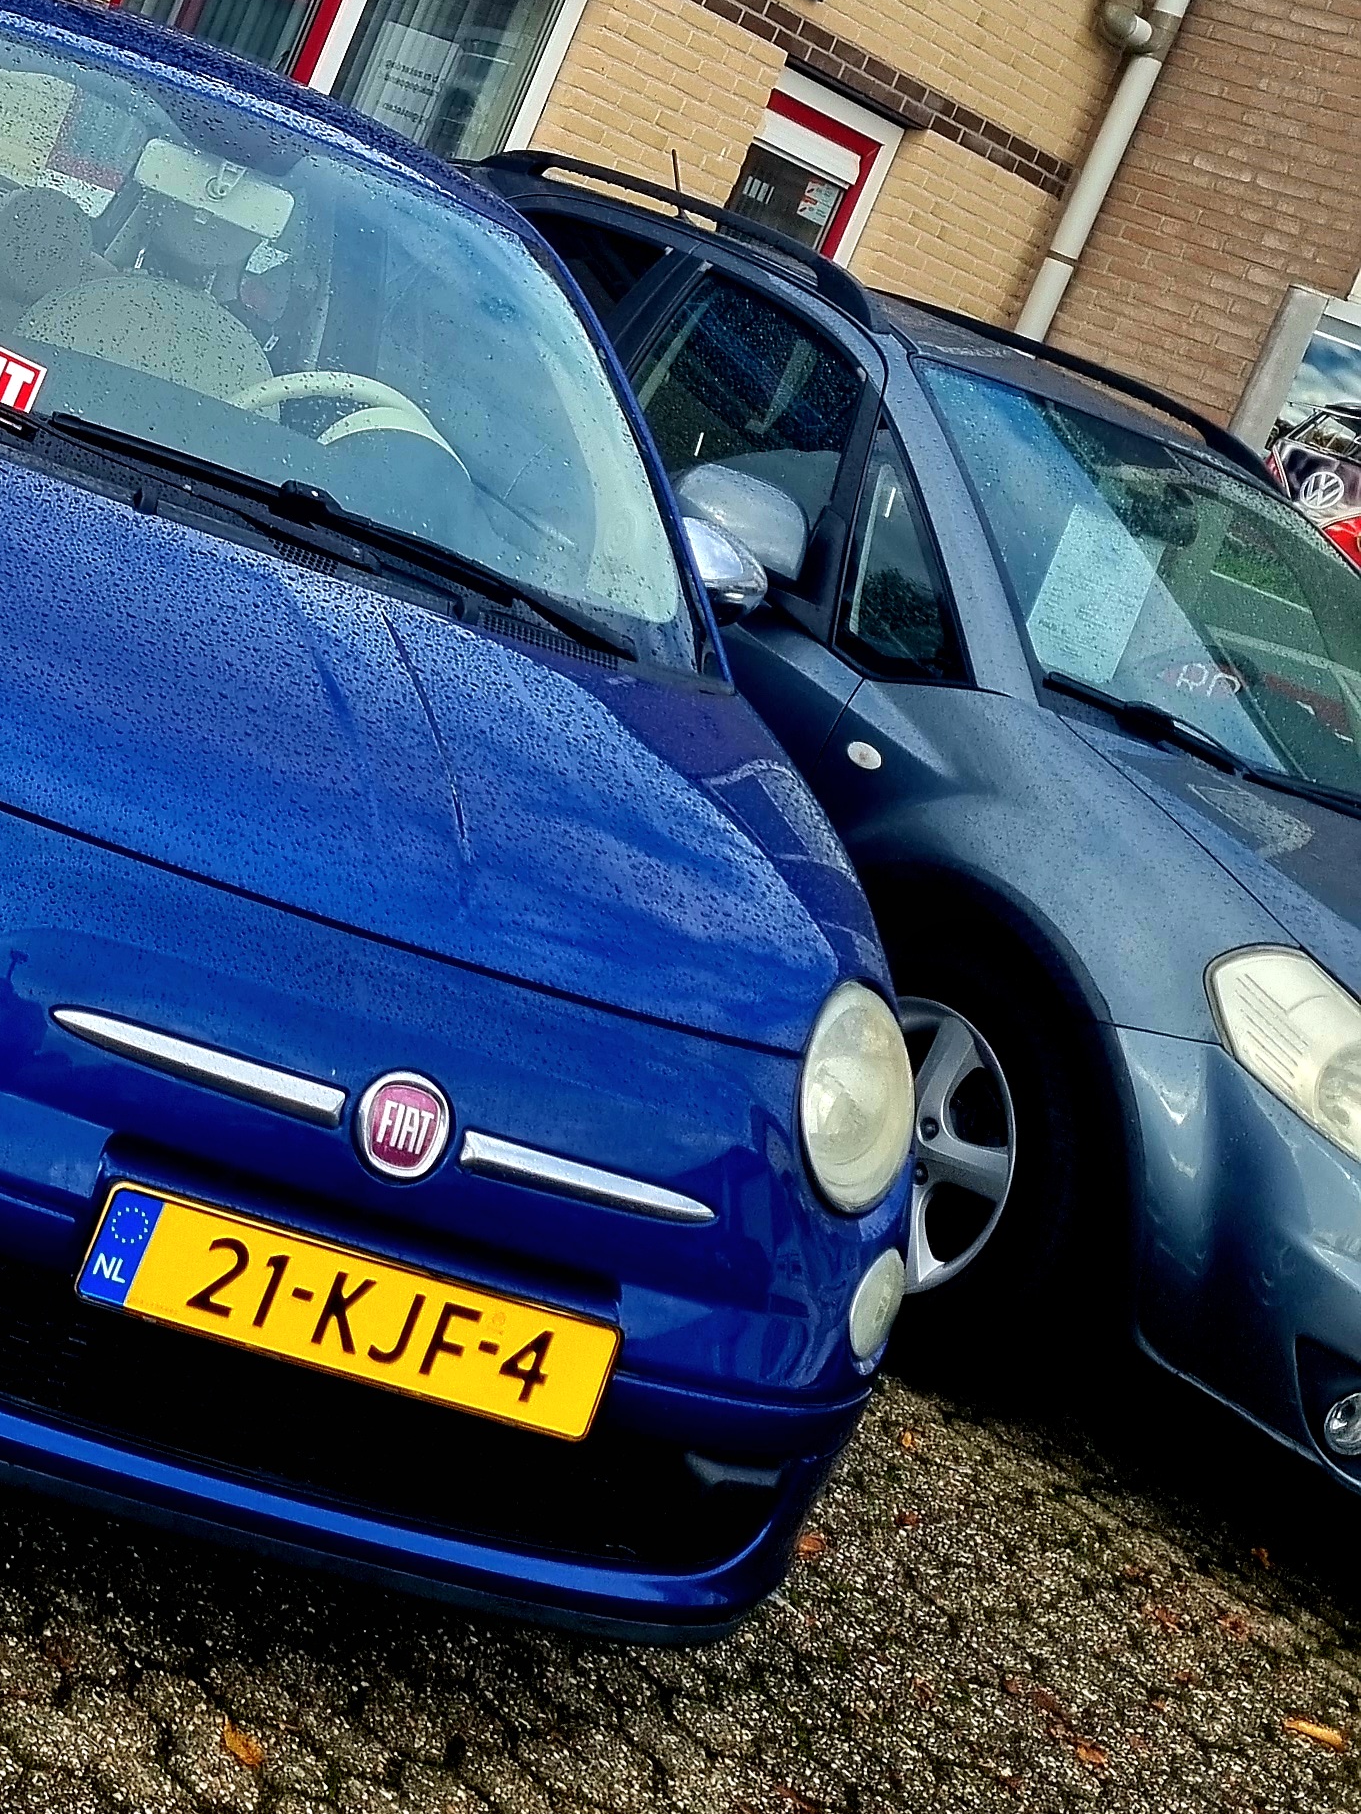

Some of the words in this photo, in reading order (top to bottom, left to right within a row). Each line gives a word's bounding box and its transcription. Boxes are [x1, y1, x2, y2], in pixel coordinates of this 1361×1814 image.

[375, 1100, 435, 1154] FIAT
[92, 1252, 126, 1284] NL
[185, 1237, 556, 1403] 21-KJF-4
